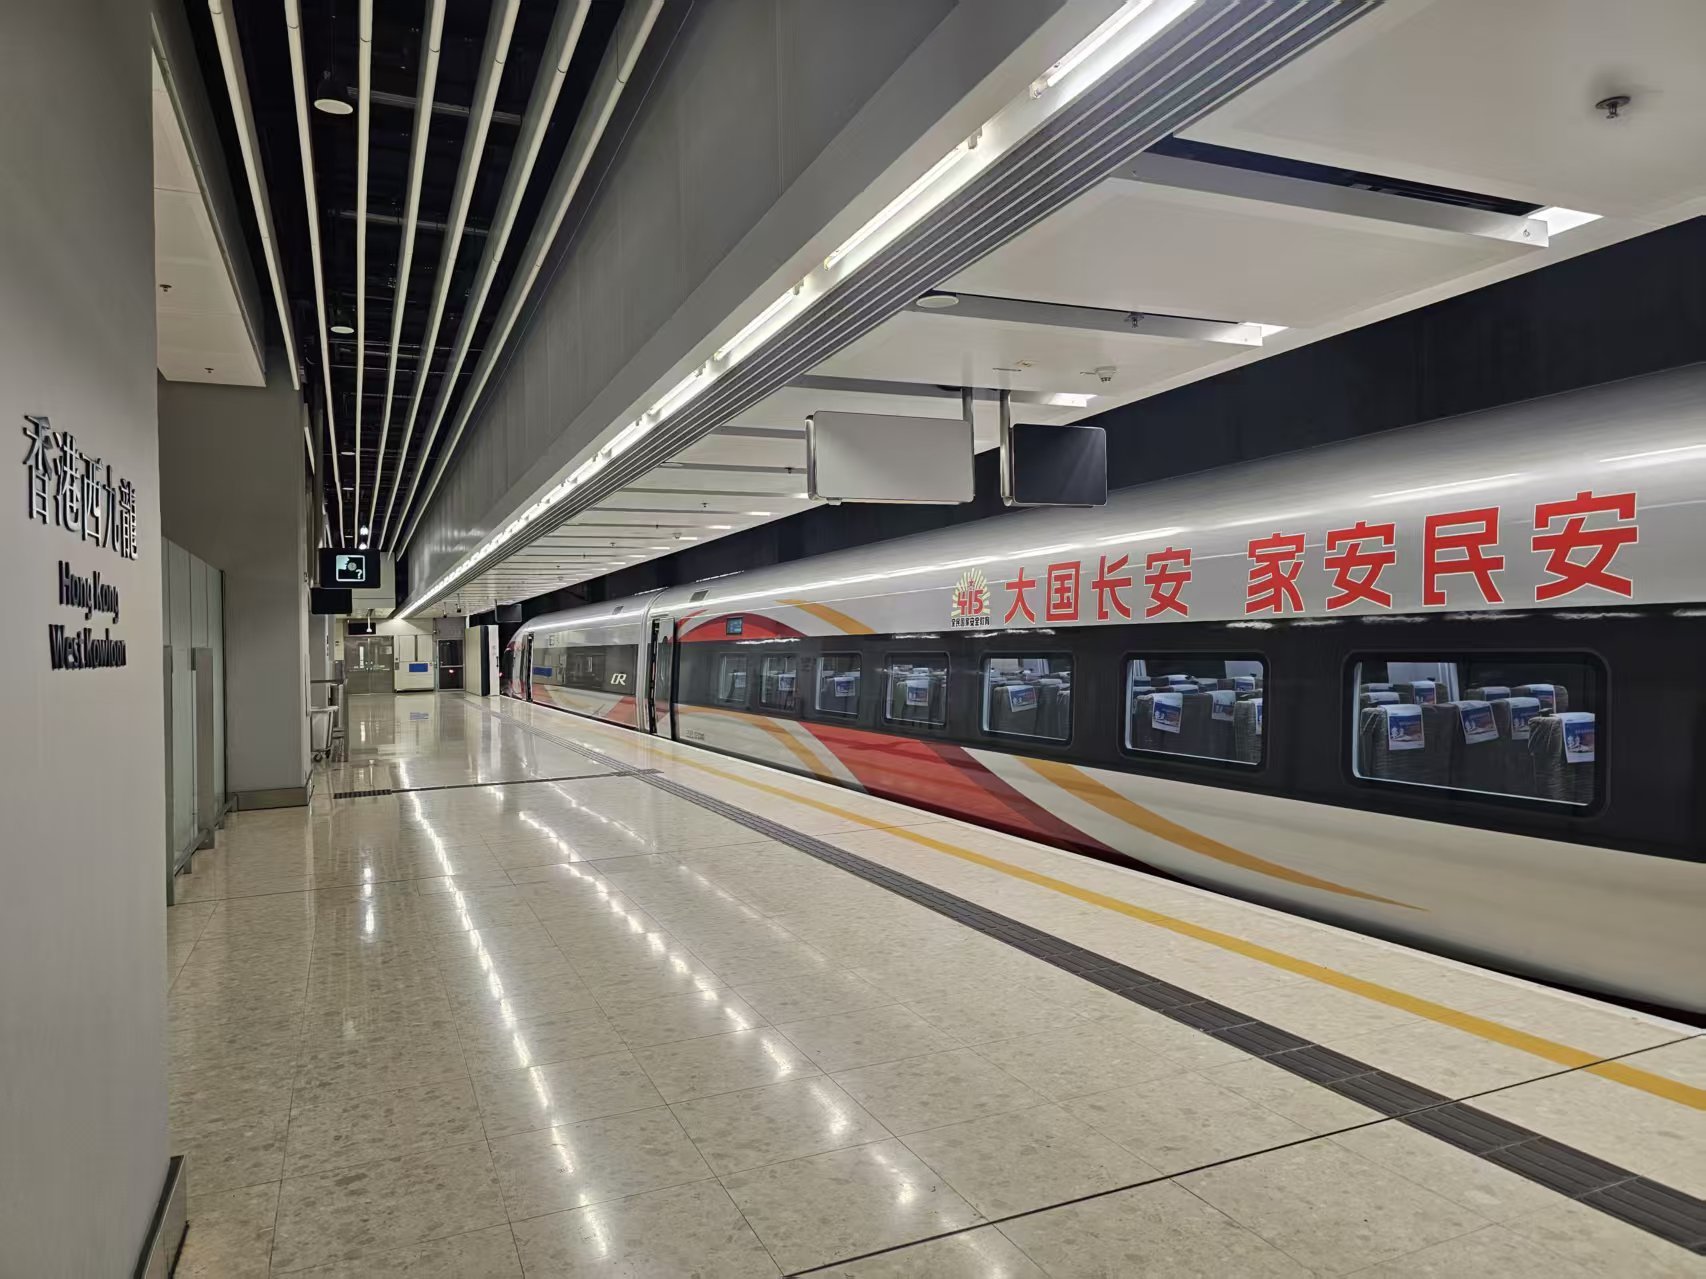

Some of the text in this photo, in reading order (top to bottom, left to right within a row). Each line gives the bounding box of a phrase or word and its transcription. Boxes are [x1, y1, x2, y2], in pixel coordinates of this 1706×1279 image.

[22, 414, 138, 560] 香港西九龍
[1004, 490, 1640, 625] 大国长安 家安民安
[58, 560, 119, 624] Hong Kong
[957, 589, 984, 616] 415
[48, 623, 127, 670] West Kowloon
